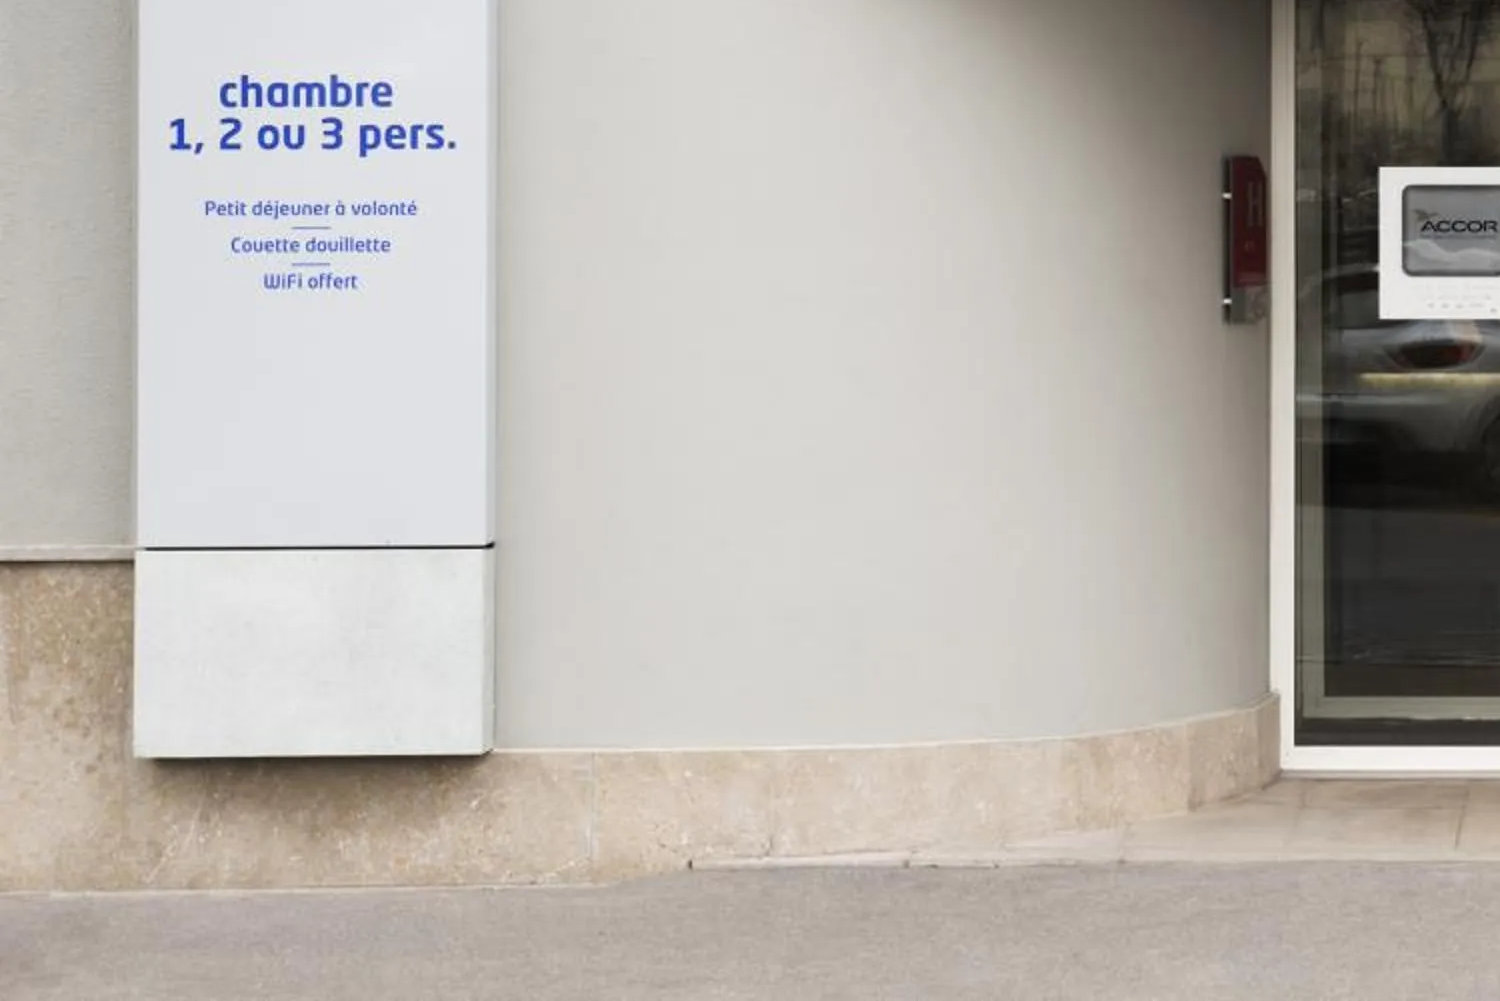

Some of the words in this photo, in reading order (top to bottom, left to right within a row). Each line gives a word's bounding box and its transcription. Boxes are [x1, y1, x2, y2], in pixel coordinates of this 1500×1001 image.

[219, 74, 393, 109] chambre
[169, 117, 205, 155] 1,
[219, 117, 243, 151] 2
[257, 123, 306, 151] ou
[321, 116, 344, 151] 3
[359, 123, 457, 158] pers.
[204, 200, 247, 217] Petit
[251, 200, 331, 221] déjeuner
[334, 199, 346, 217] à
[350, 199, 419, 217] volonté
[1420, 219, 1499, 234] ACCOR
[230, 236, 301, 254] Couette
[304, 236, 392, 254] douillette
[263, 272, 303, 290] WiFi
[307, 272, 359, 290] offert
